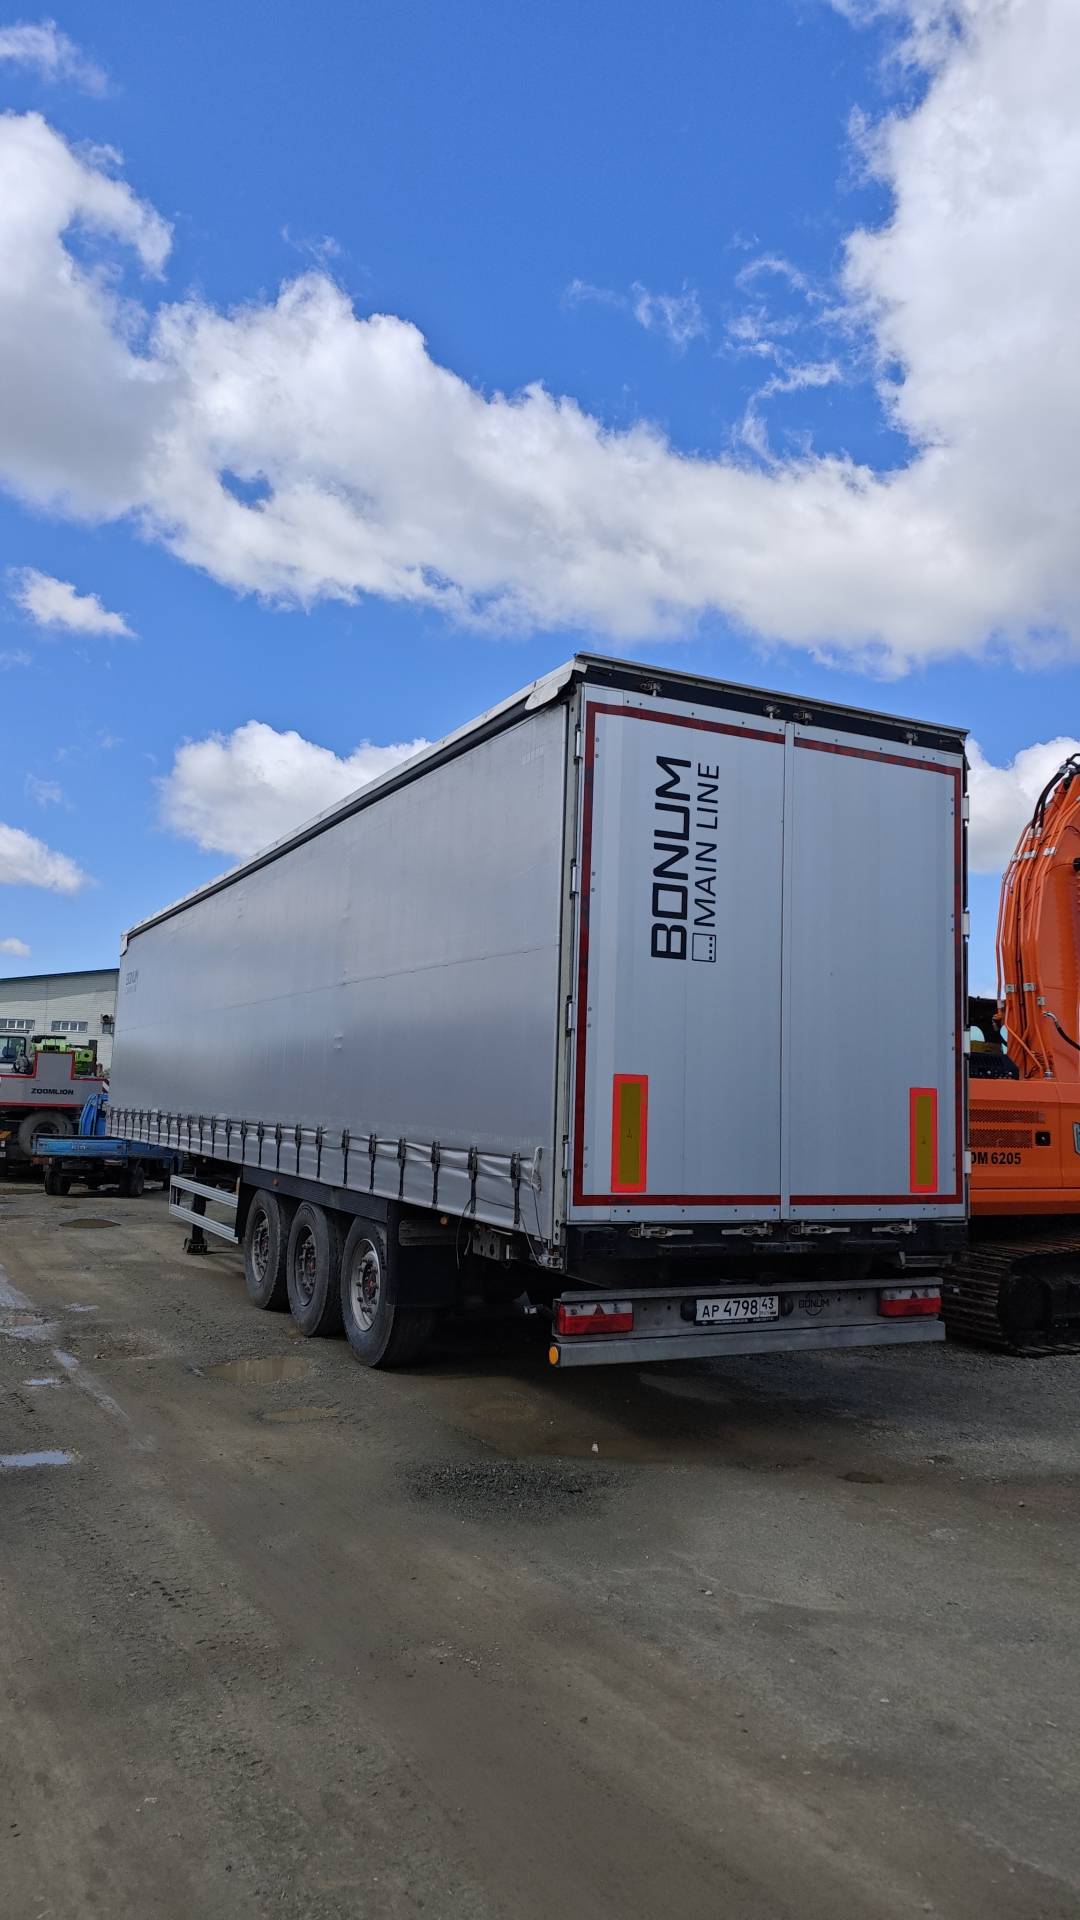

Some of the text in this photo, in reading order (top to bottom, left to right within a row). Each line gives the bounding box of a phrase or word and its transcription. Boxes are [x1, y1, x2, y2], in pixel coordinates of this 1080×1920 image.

[651, 755, 692, 960] BONUM
[694, 763, 720, 927] MAIN LINE
[991, 1152, 1021, 1165] 6205
[702, 1297, 774, 1318] AP 4798 43
